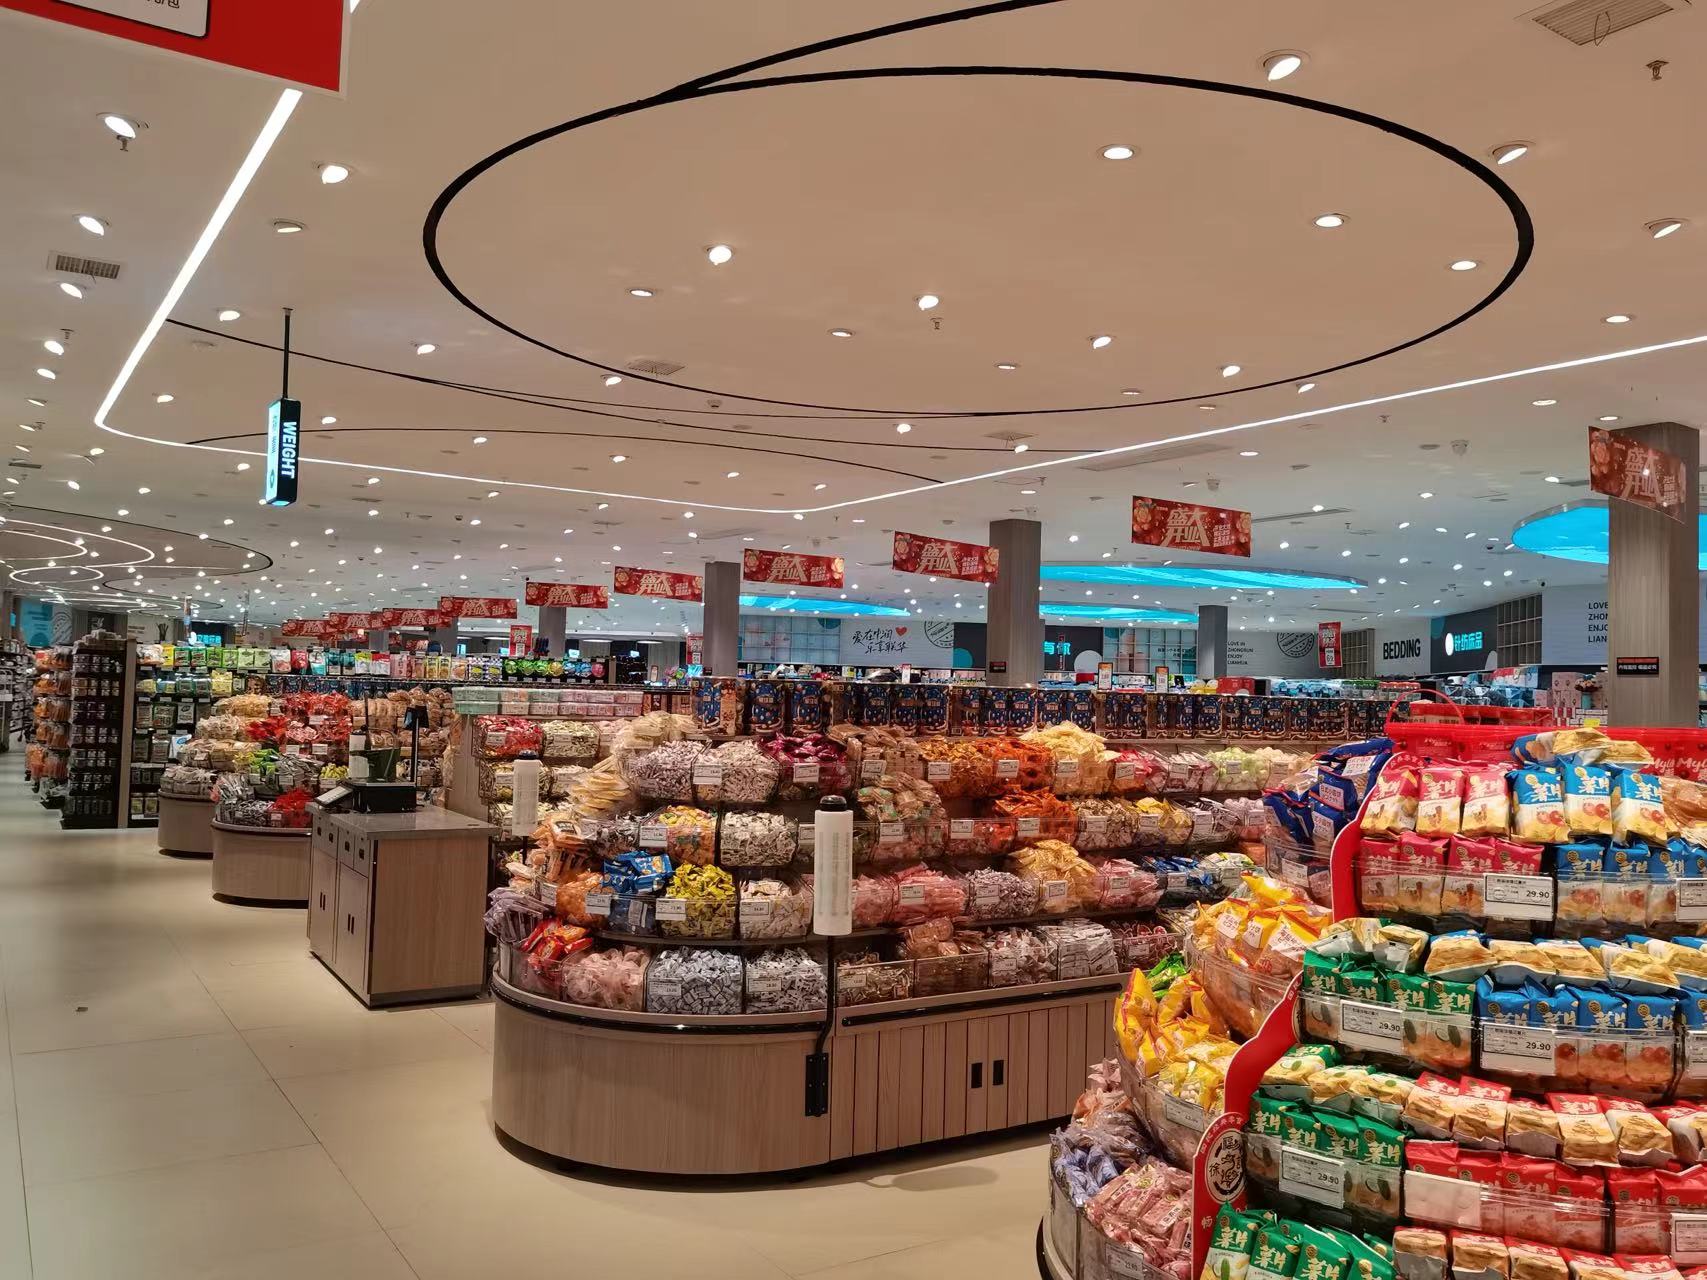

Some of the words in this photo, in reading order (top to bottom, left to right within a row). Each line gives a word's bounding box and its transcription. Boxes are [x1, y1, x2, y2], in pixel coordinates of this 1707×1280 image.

[281, 421, 297, 479] WEIGHT
[1383, 638, 1421, 660] BEDDING
[1423, 780, 1457, 801] 薯片
[1577, 774, 1609, 794] 薯片
[1526, 889, 1550, 899] 29.90
[1433, 991, 1471, 1015] 薯片
[1379, 1022, 1400, 1032] 29.90
[1526, 1041, 1551, 1051] 29.90
[1559, 1100, 1600, 1115] 薯片
[1252, 1110, 1281, 1133] 薯片
[1364, 1140, 1400, 1164] 薯片
[1317, 1172, 1340, 1185] 29.90
[1214, 1225, 1248, 1249] 薯片
[1254, 1244, 1287, 1271] 薯片
